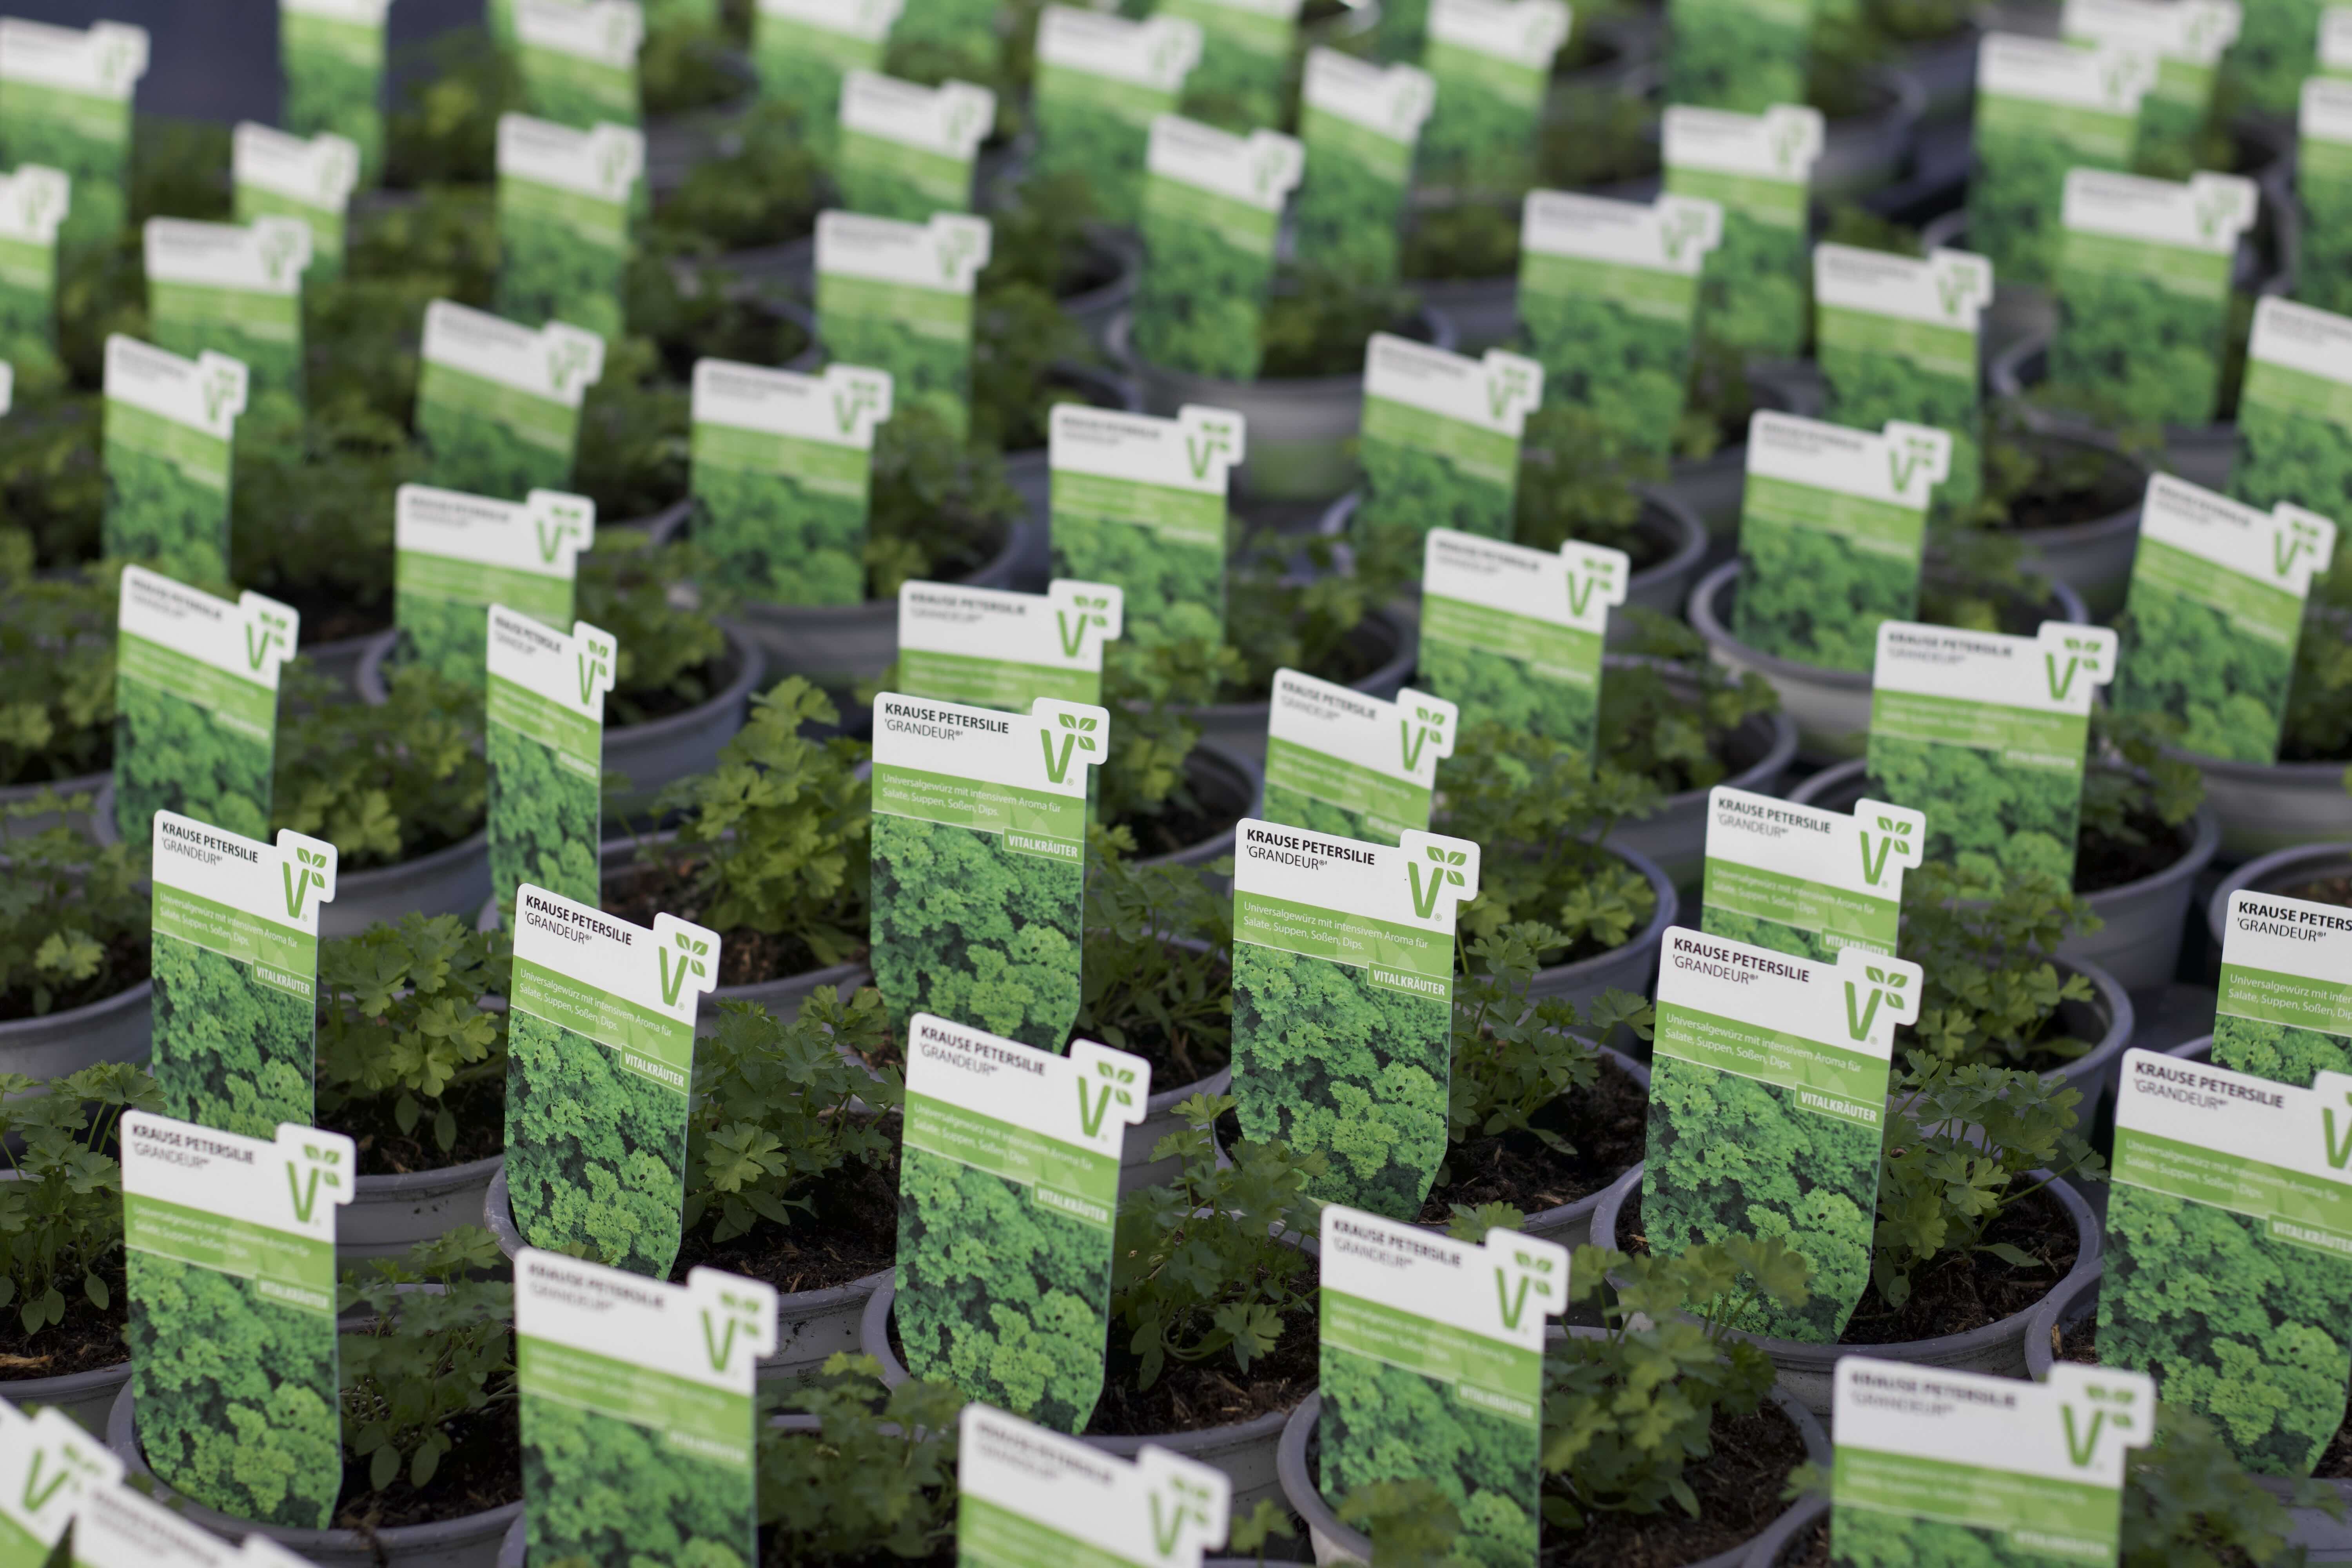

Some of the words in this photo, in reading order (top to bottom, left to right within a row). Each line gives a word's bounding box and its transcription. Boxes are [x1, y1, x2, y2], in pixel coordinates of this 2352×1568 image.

[885, 702, 936, 722] KRAUSE
[938, 711, 1009, 734] PETERSILIE
[882, 773, 953, 794] Universalgewürz
[954, 786, 969, 797] mit
[970, 788, 1017, 805] intensivem
[1018, 797, 1047, 810] Aroma
[1048, 801, 1061, 813] für
[882, 787, 910, 802] Salate,
[911, 792, 946, 808] Suppen,
[947, 799, 977, 813] Soßen,
[978, 804, 999, 817] Dips.
[1718, 797, 1765, 818] KRAUSE
[1766, 808, 1831, 834] PETERSILIE
[162, 821, 201, 845] KRAUSE
[203, 834, 258, 864] PETERSILIE
[1008, 834, 1077, 858] VITALKRÄUTER
[1247, 828, 1299, 850] KRAUSE
[1302, 839, 1375, 866] PETERSILIE
[160, 892, 214, 919] Universalgewürz
[214, 913, 227, 924] mit
[227, 915, 263, 936] intensivem
[264, 928, 287, 944] Aroma
[287, 936, 298, 948] für
[526, 894, 570, 922] KRAUSE
[571, 911, 632, 946] PETERSILIE
[1244, 900, 1316, 925] Universalgewürz
[1318, 918, 1333, 929] mit
[1334, 920, 1382, 939] intensivem
[1384, 931, 1414, 946] Aroma
[1415, 937, 1428, 949] für
[2238, 901, 2297, 922] KRAUSE
[1243, 915, 1272, 931] Salate,
[1273, 922, 1309, 939] Suppen,
[1310, 929, 1341, 946] Soßen,
[1343, 936, 1364, 950] Dips.
[1673, 937, 1730, 963] KRAUSE
[1732, 951, 1810, 983] PETERSILIE
[256, 965, 310, 995] VITALKRÄUTER
[1373, 969, 1445, 996] VITALKRÄUTER
[2230, 973, 2310, 996] Universalgewürz
[2311, 989, 2328, 1000] mit
[519, 983, 543, 1002] Salate,
[543, 992, 573, 1014] Suppen,
[574, 1005, 599, 1024] Soßen,
[600, 1015, 619, 1031] Dips.
[520, 967, 580, 1000] Universalgewürz
[581, 994, 593, 1006] mit
[594, 997, 634, 1022] intensivem
[635, 1014, 660, 1033] Aroma
[661, 1024, 672, 1037] für
[2228, 988, 2259, 1004] Salate,
[2260, 994, 2300, 1011] Suppen,
[2301, 1001, 2335, 1017] Soßen,
[920, 1025, 972, 1053] KRAUSE
[974, 1042, 1045, 1076] PETERSILIE
[1664, 1028, 1695, 1045] Salate,
[1696, 1036, 1734, 1056] Suppen,
[1735, 1046, 1768, 1065] Soßen,
[1769, 1055, 1793, 1070] Dips.
[1666, 1012, 1743, 1041] Universalgewürz
[1744, 1035, 1760, 1046] mit
[1762, 1037, 1813, 1060] intensivem
[1814, 1051, 1846, 1069] Aroma
[1847, 1060, 1862, 1073] für
[624, 1052, 684, 1088] VITALKRÄUTER
[2135, 1060, 2197, 1087] KRAUSE
[2199, 1076, 2285, 1109] PETERSILIE
[1800, 1091, 1877, 1123] VITALKRÄUTER
